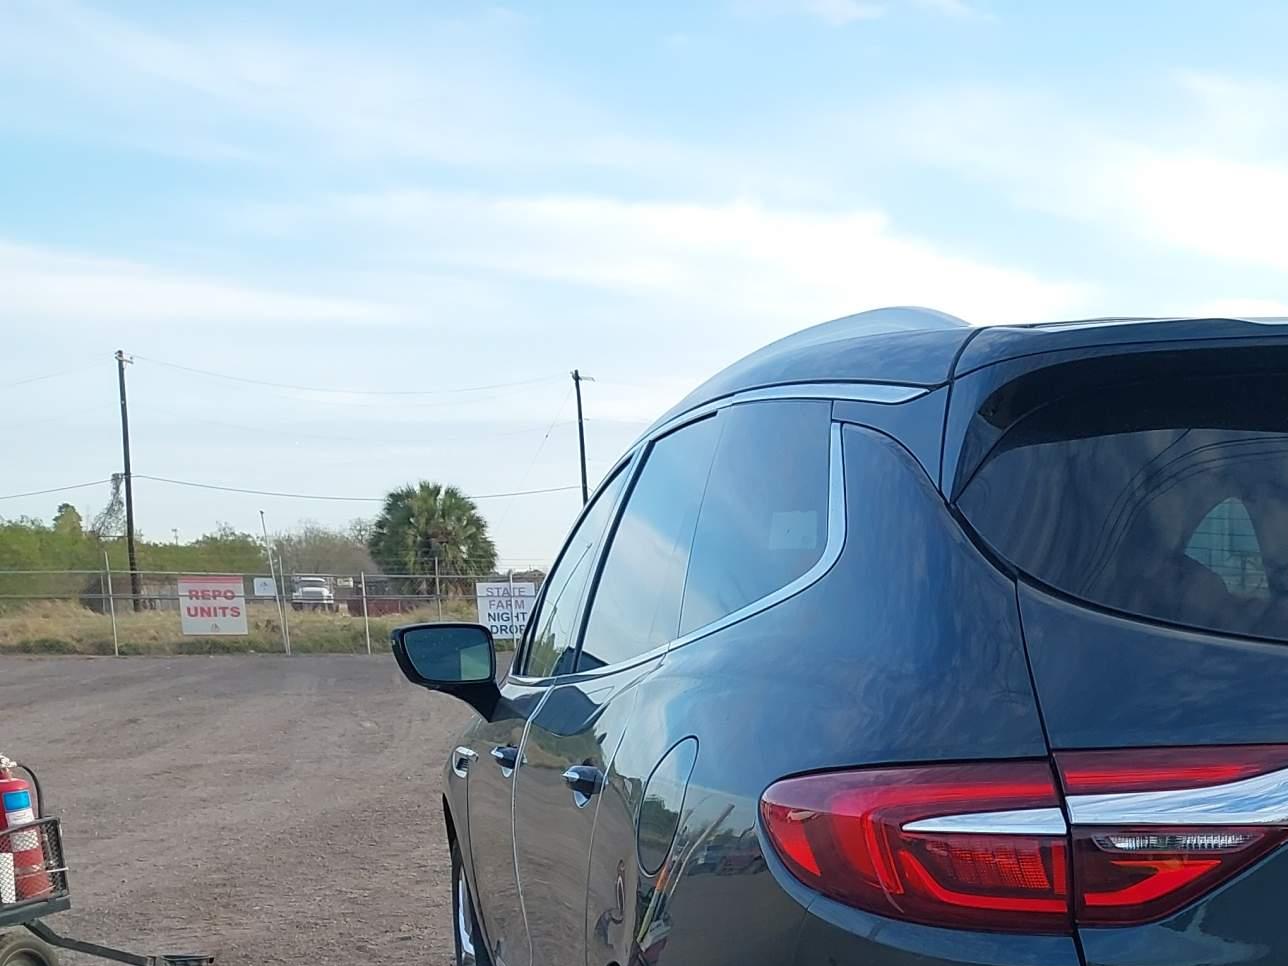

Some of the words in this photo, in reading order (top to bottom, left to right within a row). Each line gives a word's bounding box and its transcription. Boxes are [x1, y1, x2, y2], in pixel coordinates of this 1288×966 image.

[188, 589, 235, 600] REPO
[486, 587, 526, 597] STATE
[488, 599, 525, 609] FARM
[186, 606, 241, 617] UNITS
[487, 611, 528, 622] NIGHT
